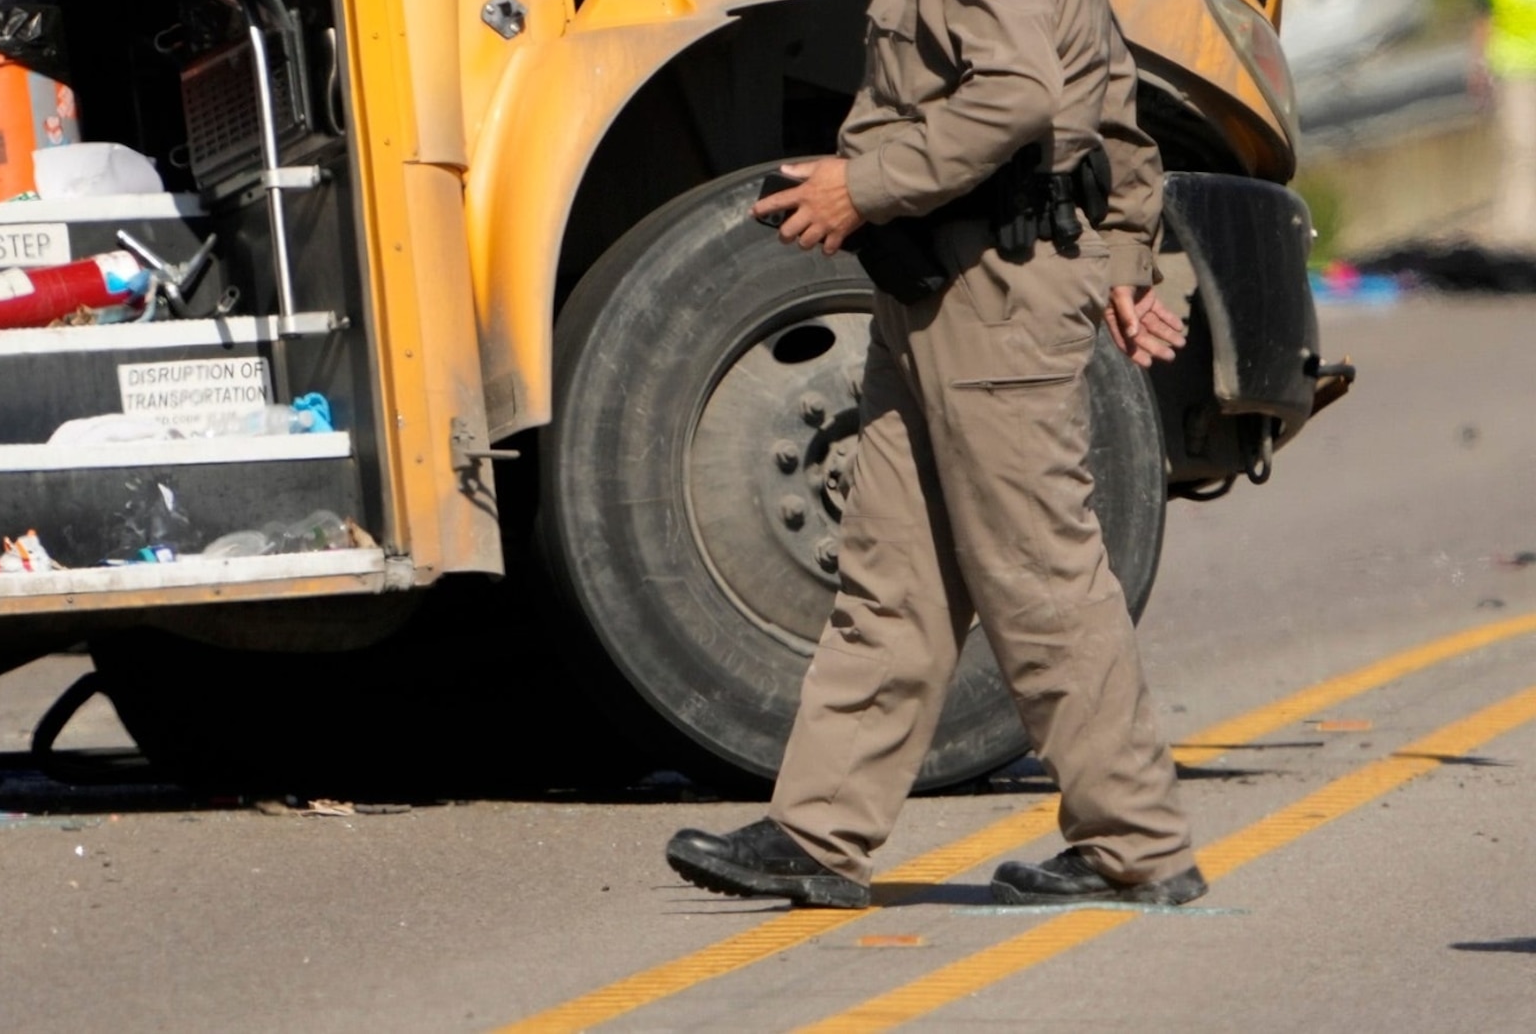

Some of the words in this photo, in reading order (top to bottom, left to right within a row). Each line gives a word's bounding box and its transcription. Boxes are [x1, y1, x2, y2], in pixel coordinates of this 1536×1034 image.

[129, 362, 235, 386] DISRUPTION
[241, 361, 265, 379] OF
[126, 385, 268, 410] TRANSPORTATION
